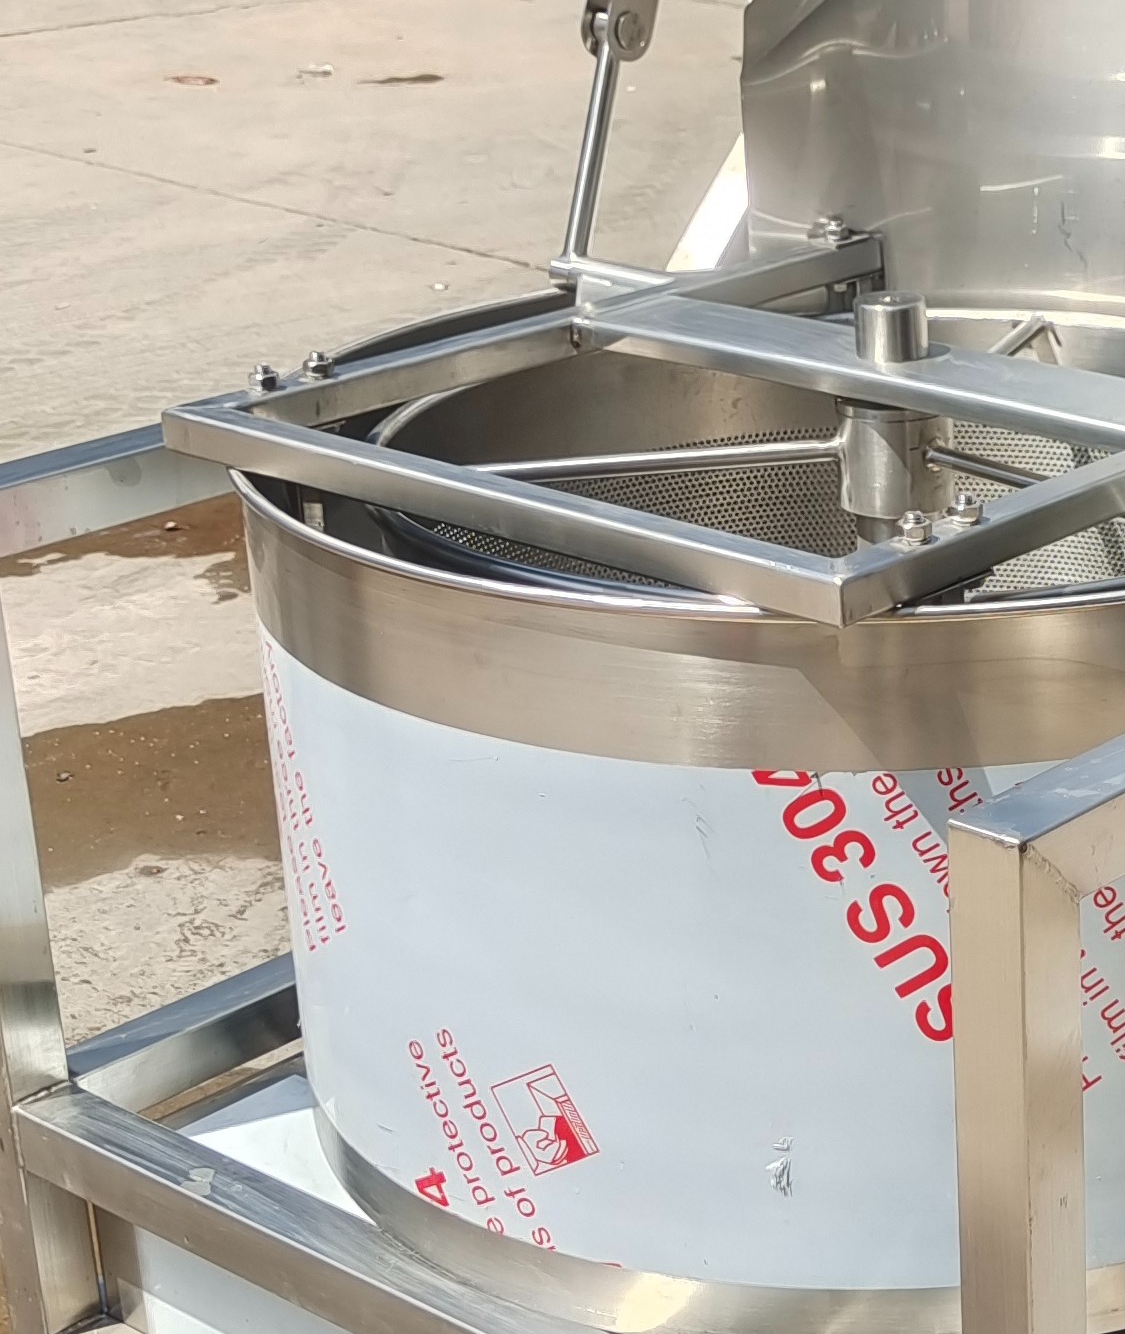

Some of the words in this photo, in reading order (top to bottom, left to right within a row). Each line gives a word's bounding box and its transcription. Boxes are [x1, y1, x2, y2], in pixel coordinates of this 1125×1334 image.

[265, 640, 297, 759] factory
[295, 771, 313, 828] the
[871, 772, 919, 831] the
[298, 841, 311, 873] in
[312, 837, 347, 934] leave
[309, 882, 330, 944] film
[847, 883, 956, 1044] SUS
[408, 1040, 495, 1206] protective
[437, 1029, 521, 1177] products
[415, 1167, 450, 1207] 4
[505, 1188, 536, 1218] of
